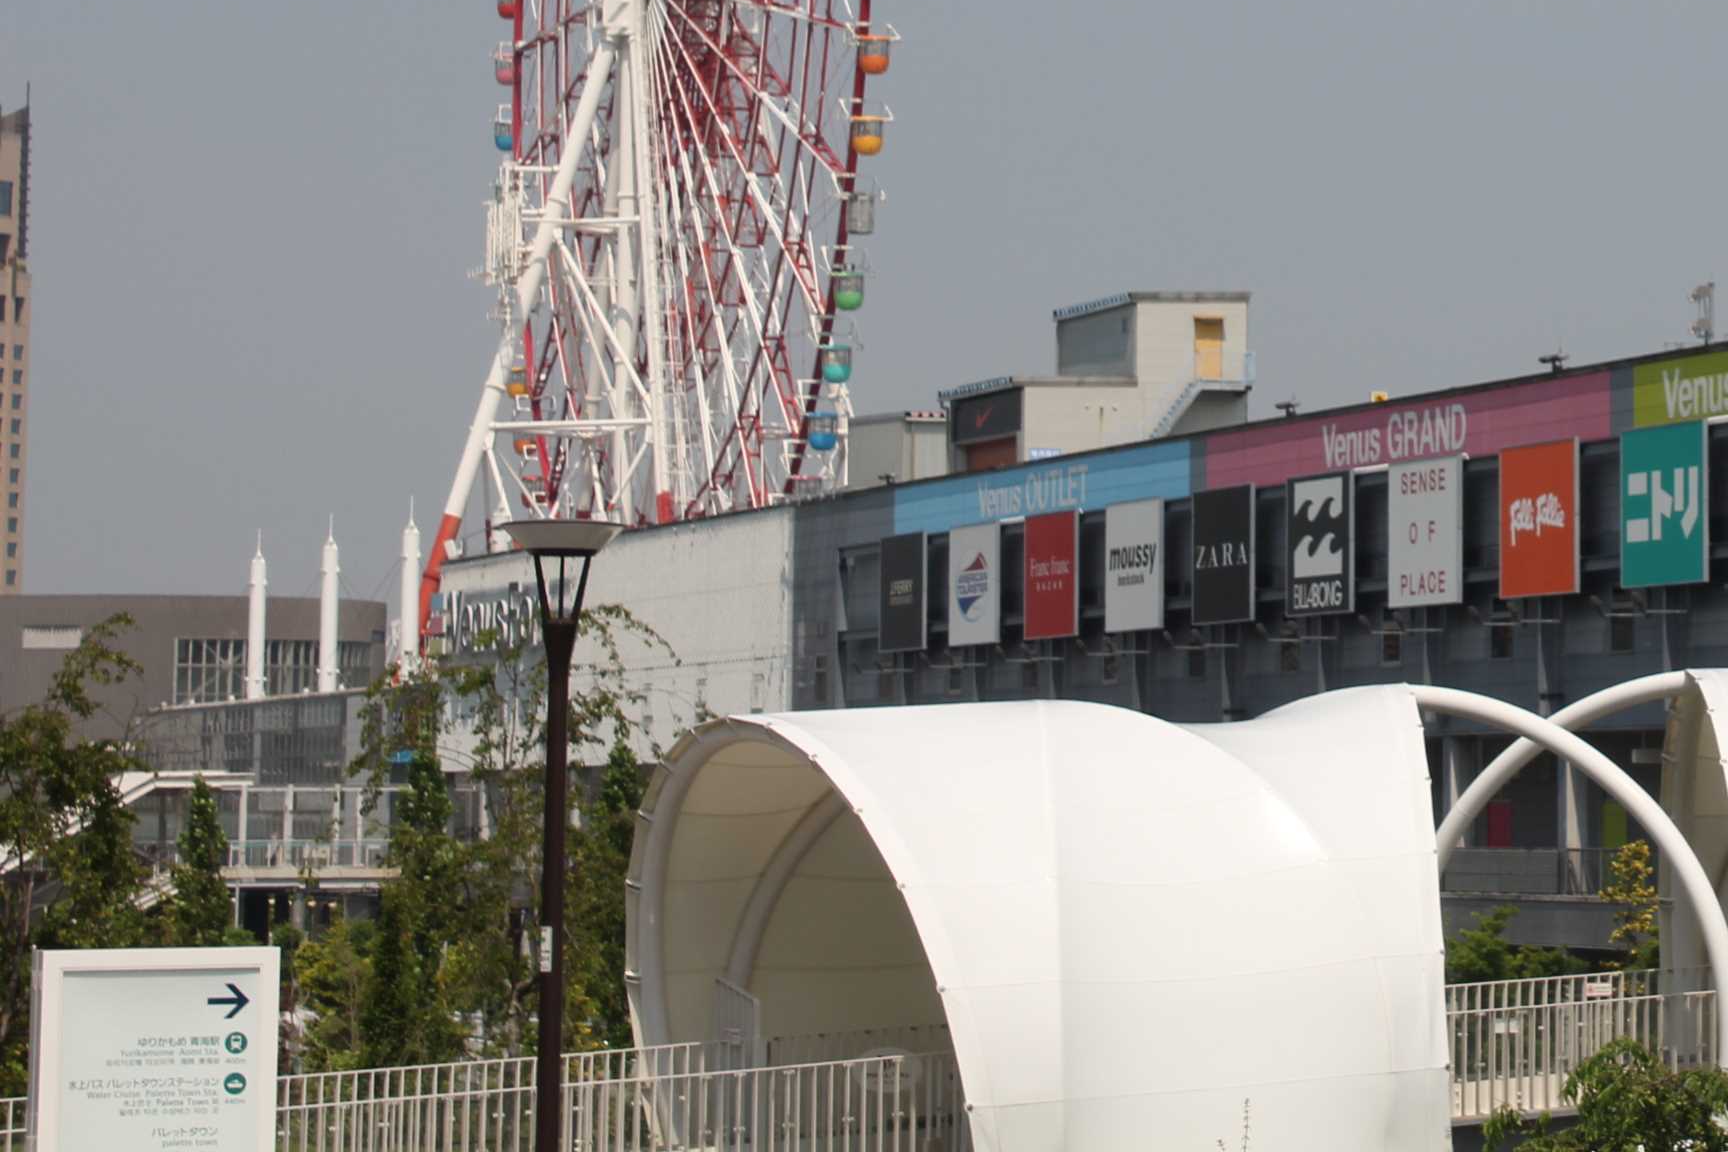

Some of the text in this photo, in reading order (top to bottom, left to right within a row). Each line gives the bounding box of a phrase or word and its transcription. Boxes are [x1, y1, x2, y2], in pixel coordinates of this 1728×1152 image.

[1323, 403, 1467, 469] Venus GRAND
[977, 464, 1089, 519] Venus OUTLET
[1401, 468, 1446, 495] SENSE
[1408, 520, 1436, 545] OF
[1109, 543, 1157, 575] moussy
[1195, 541, 1249, 569] ZARA
[1294, 580, 1343, 609] BILLABONG
[1401, 571, 1446, 597] PLACE
[137, 1037, 187, 1047] ゆりかもめ
[69, 1078, 220, 1090] 水上バス パレットタウンステーション
[178, 1089, 201, 1097] Town
[151, 1127, 219, 1137] パレットタウン
